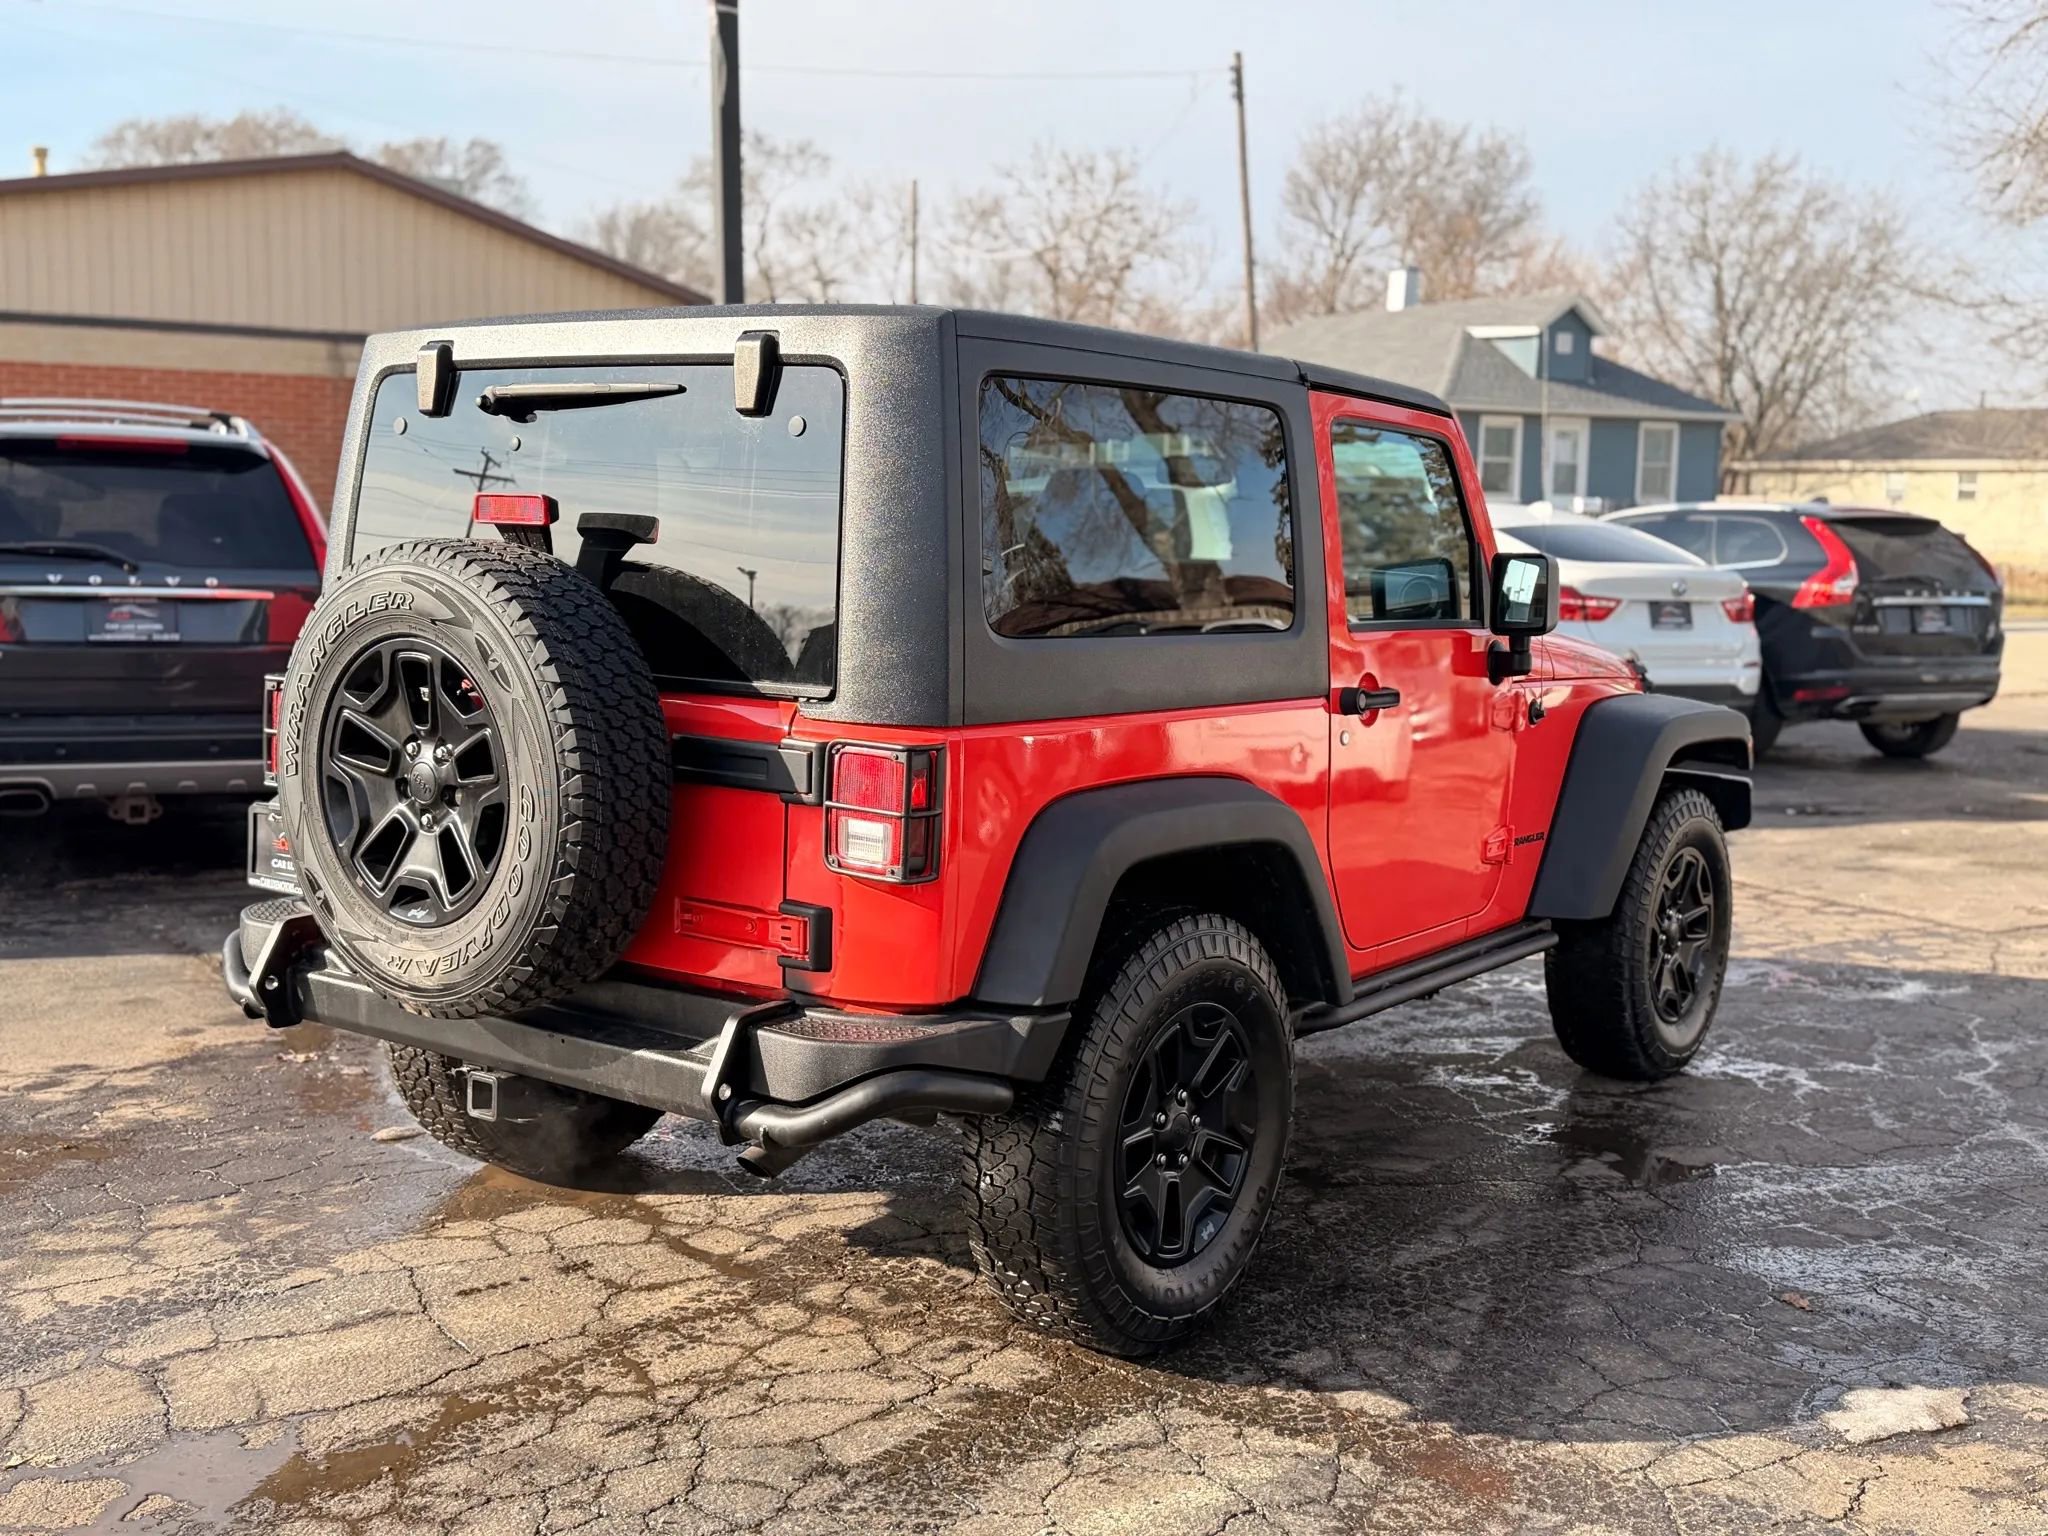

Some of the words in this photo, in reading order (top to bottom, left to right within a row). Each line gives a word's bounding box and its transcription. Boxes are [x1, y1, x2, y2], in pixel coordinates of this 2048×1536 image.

[46, 573, 219, 586] VOLVO
[285, 590, 415, 778] WRANGLER
[388, 783, 536, 978] GOODYEAR
[1514, 832, 1545, 846] RANGLER
